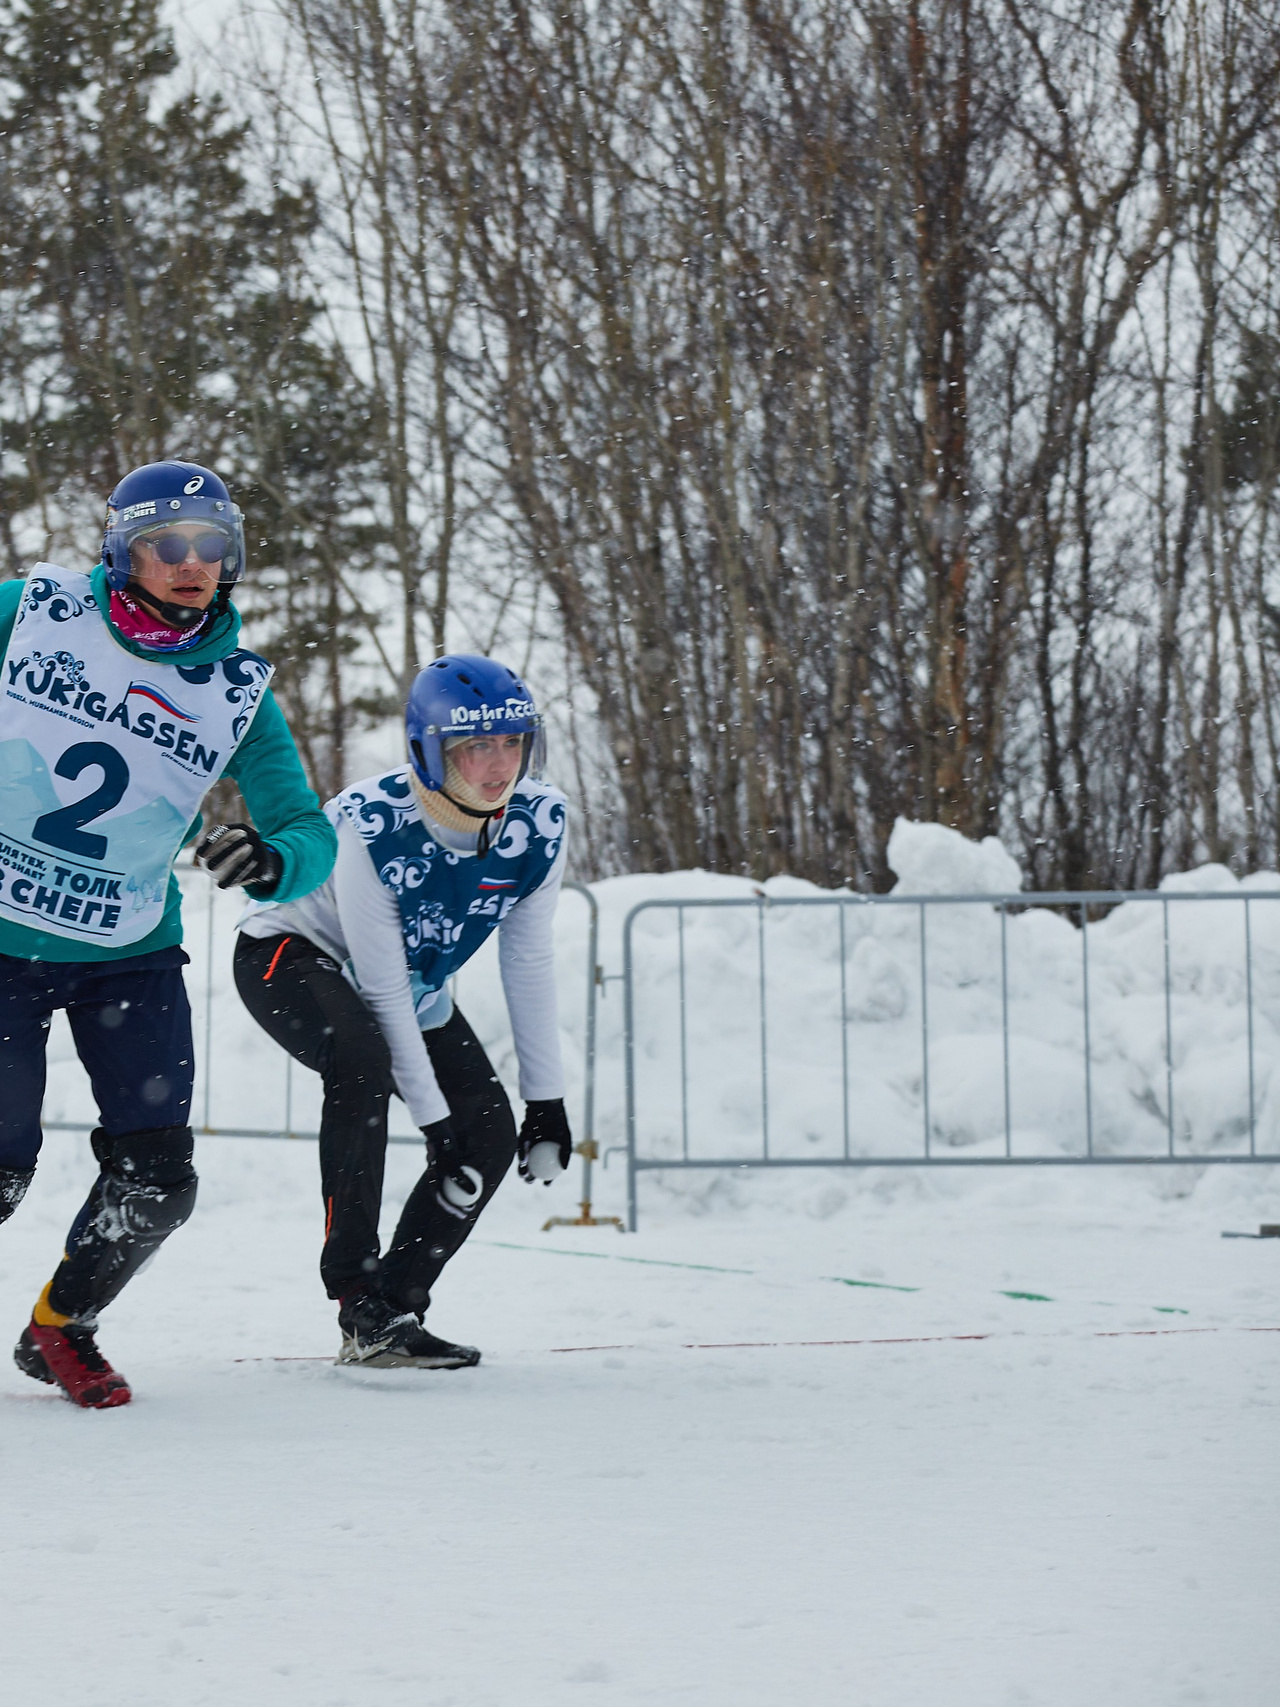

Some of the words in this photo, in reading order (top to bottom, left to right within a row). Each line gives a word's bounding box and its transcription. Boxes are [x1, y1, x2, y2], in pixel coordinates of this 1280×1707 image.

[28, 699, 68, 718] MURMANSK
[68, 714, 95, 730] REGION
[31, 741, 130, 861] 2
[10, 861, 46, 880] ЗНАЕТ
[21, 852, 47, 872] ТЕХ,
[53, 865, 122, 900] ТОЛК
[11, 878, 122, 929] СНЕГЕ
